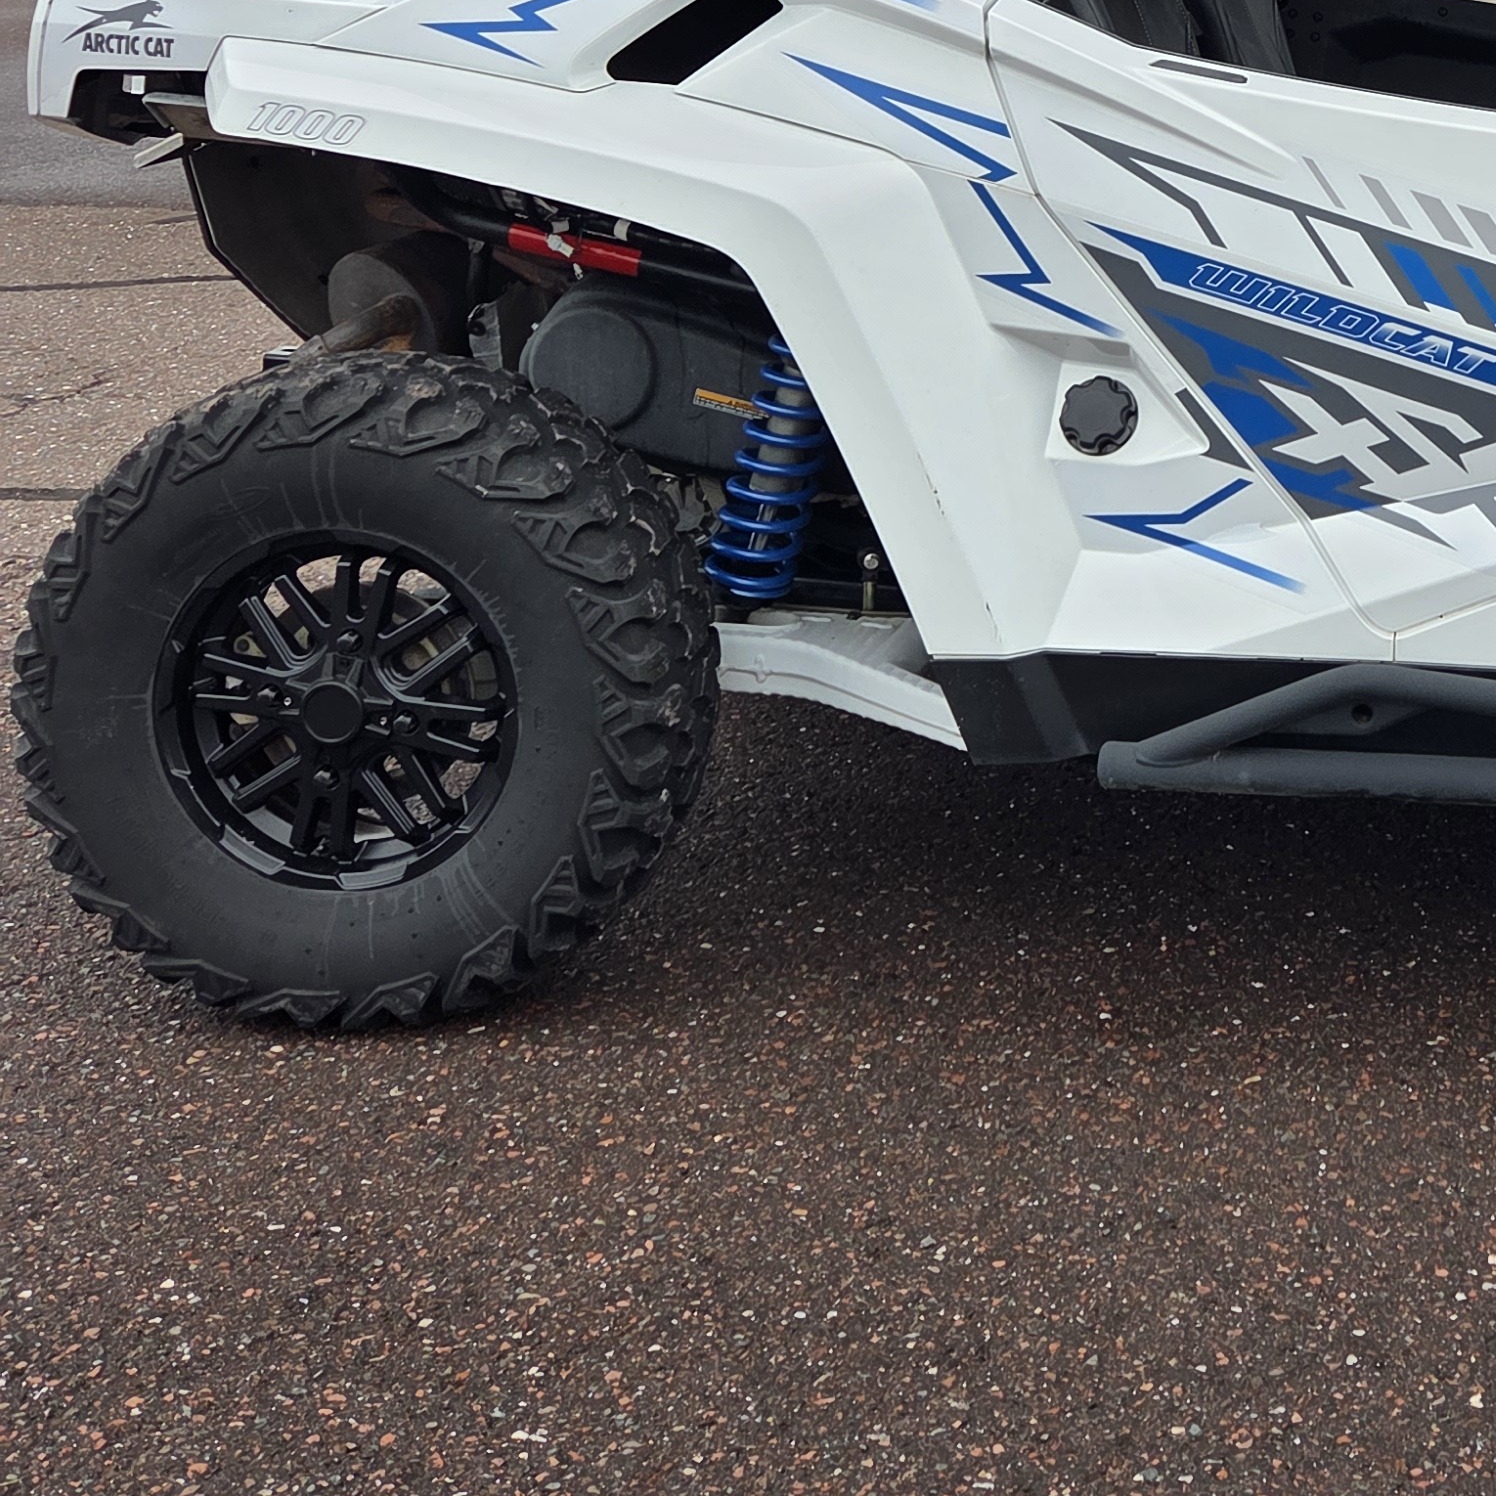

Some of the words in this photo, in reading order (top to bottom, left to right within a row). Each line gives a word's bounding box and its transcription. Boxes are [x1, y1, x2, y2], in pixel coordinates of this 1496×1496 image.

[82, 31, 140, 55] ARCTIC
[143, 36, 175, 58] CAT
[246, 101, 366, 145] 1000
